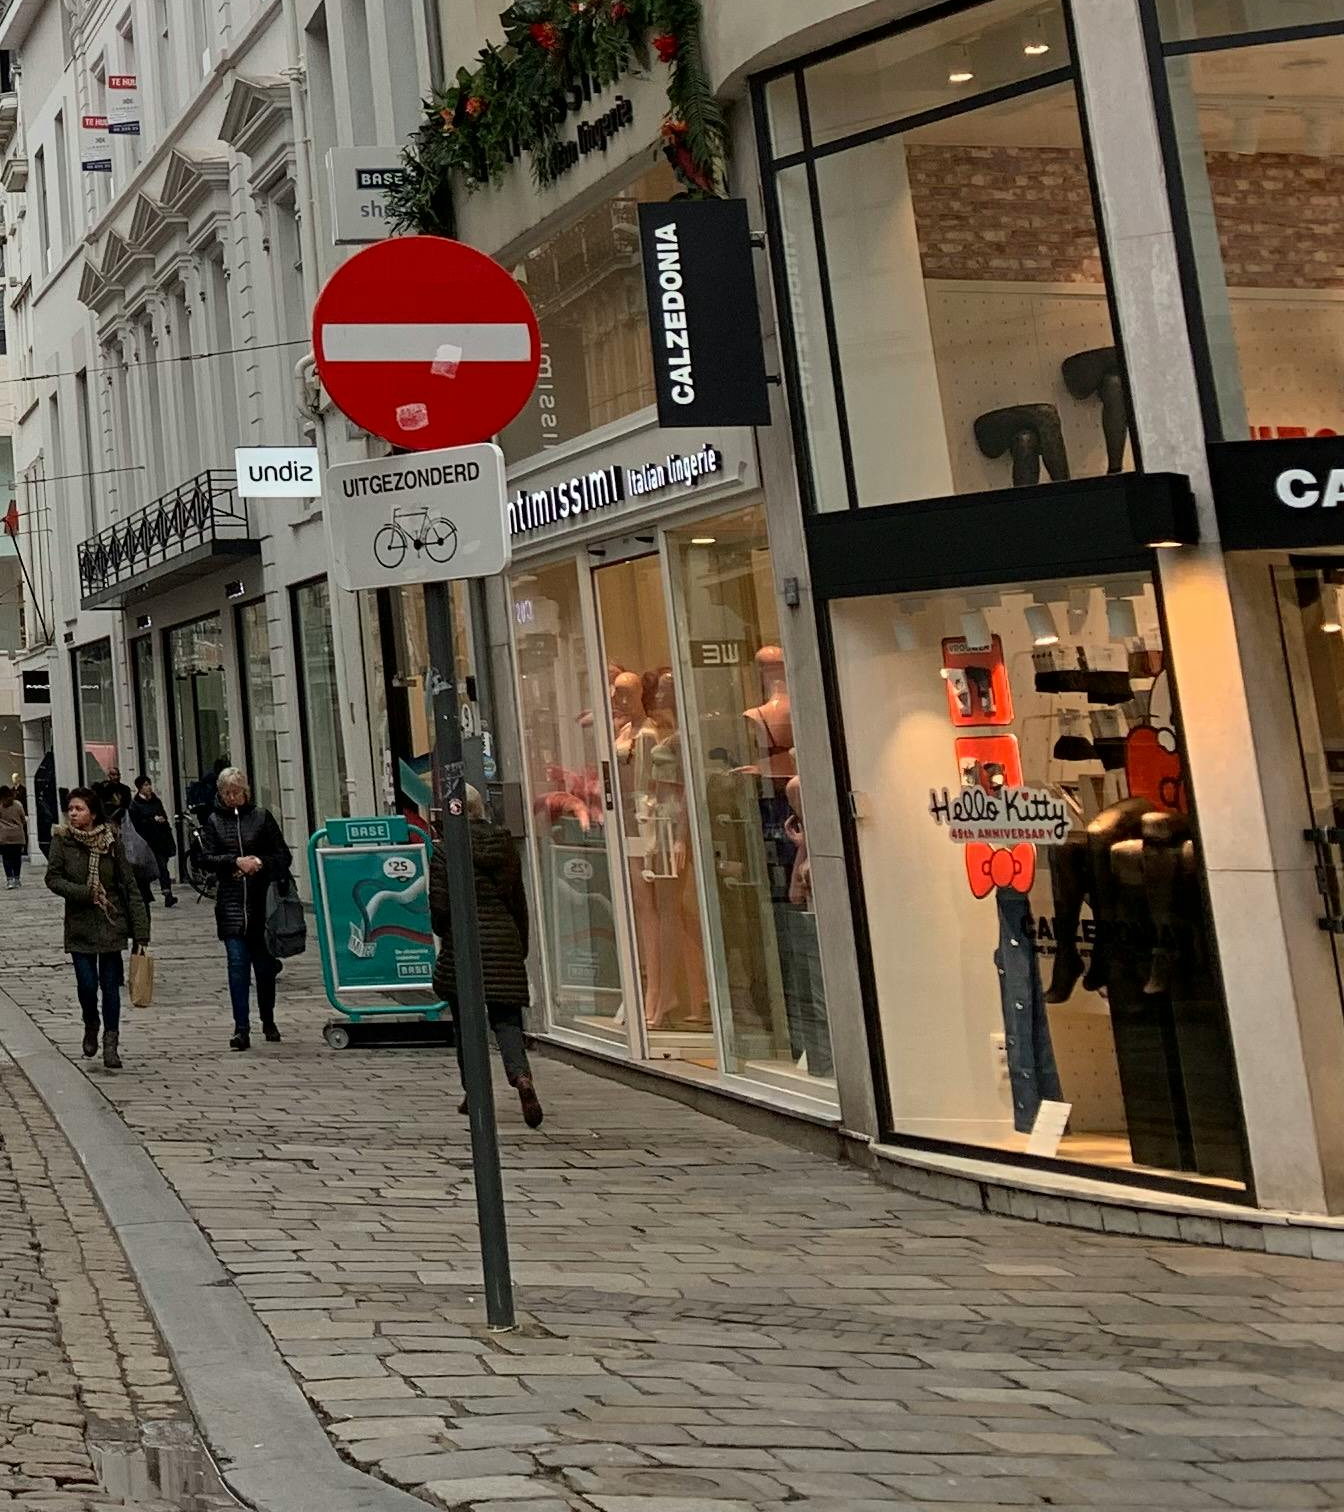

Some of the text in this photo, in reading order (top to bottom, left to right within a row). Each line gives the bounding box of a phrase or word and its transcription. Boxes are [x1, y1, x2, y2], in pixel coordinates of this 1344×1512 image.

[360, 172, 404, 186] BASE
[654, 222, 695, 405] CALZEDONIA
[247, 459, 314, 483] undiz
[342, 461, 481, 500] UITGEZONDERD
[665, 443, 718, 487] lingerie
[930, 787, 1069, 839] Hello Kitty
[350, 825, 386, 837] BASE
[977, 828, 1054, 839] ANNIVERSARY
